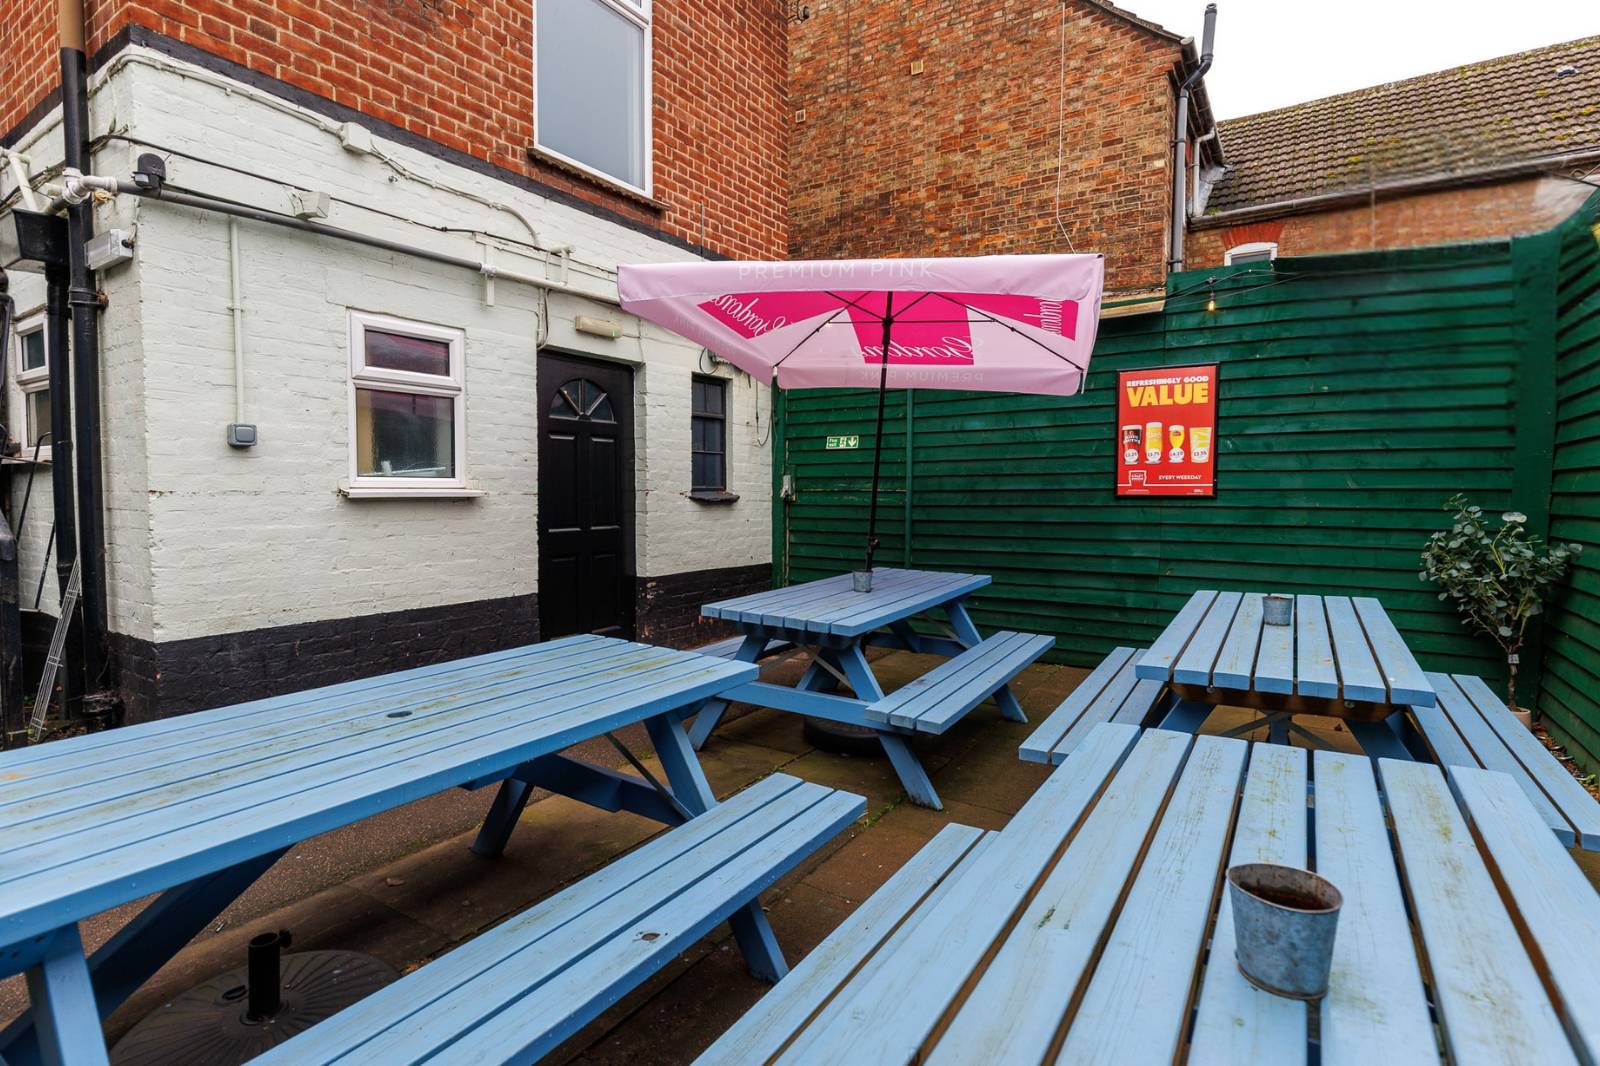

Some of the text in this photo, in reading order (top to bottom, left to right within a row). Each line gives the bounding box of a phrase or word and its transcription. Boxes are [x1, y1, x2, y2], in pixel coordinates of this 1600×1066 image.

[738, 261, 936, 280] PREMIUM PINK
[1126, 375, 1209, 387] REFRESHINGLY GOOD
[1126, 383, 1209, 407] VALUE
